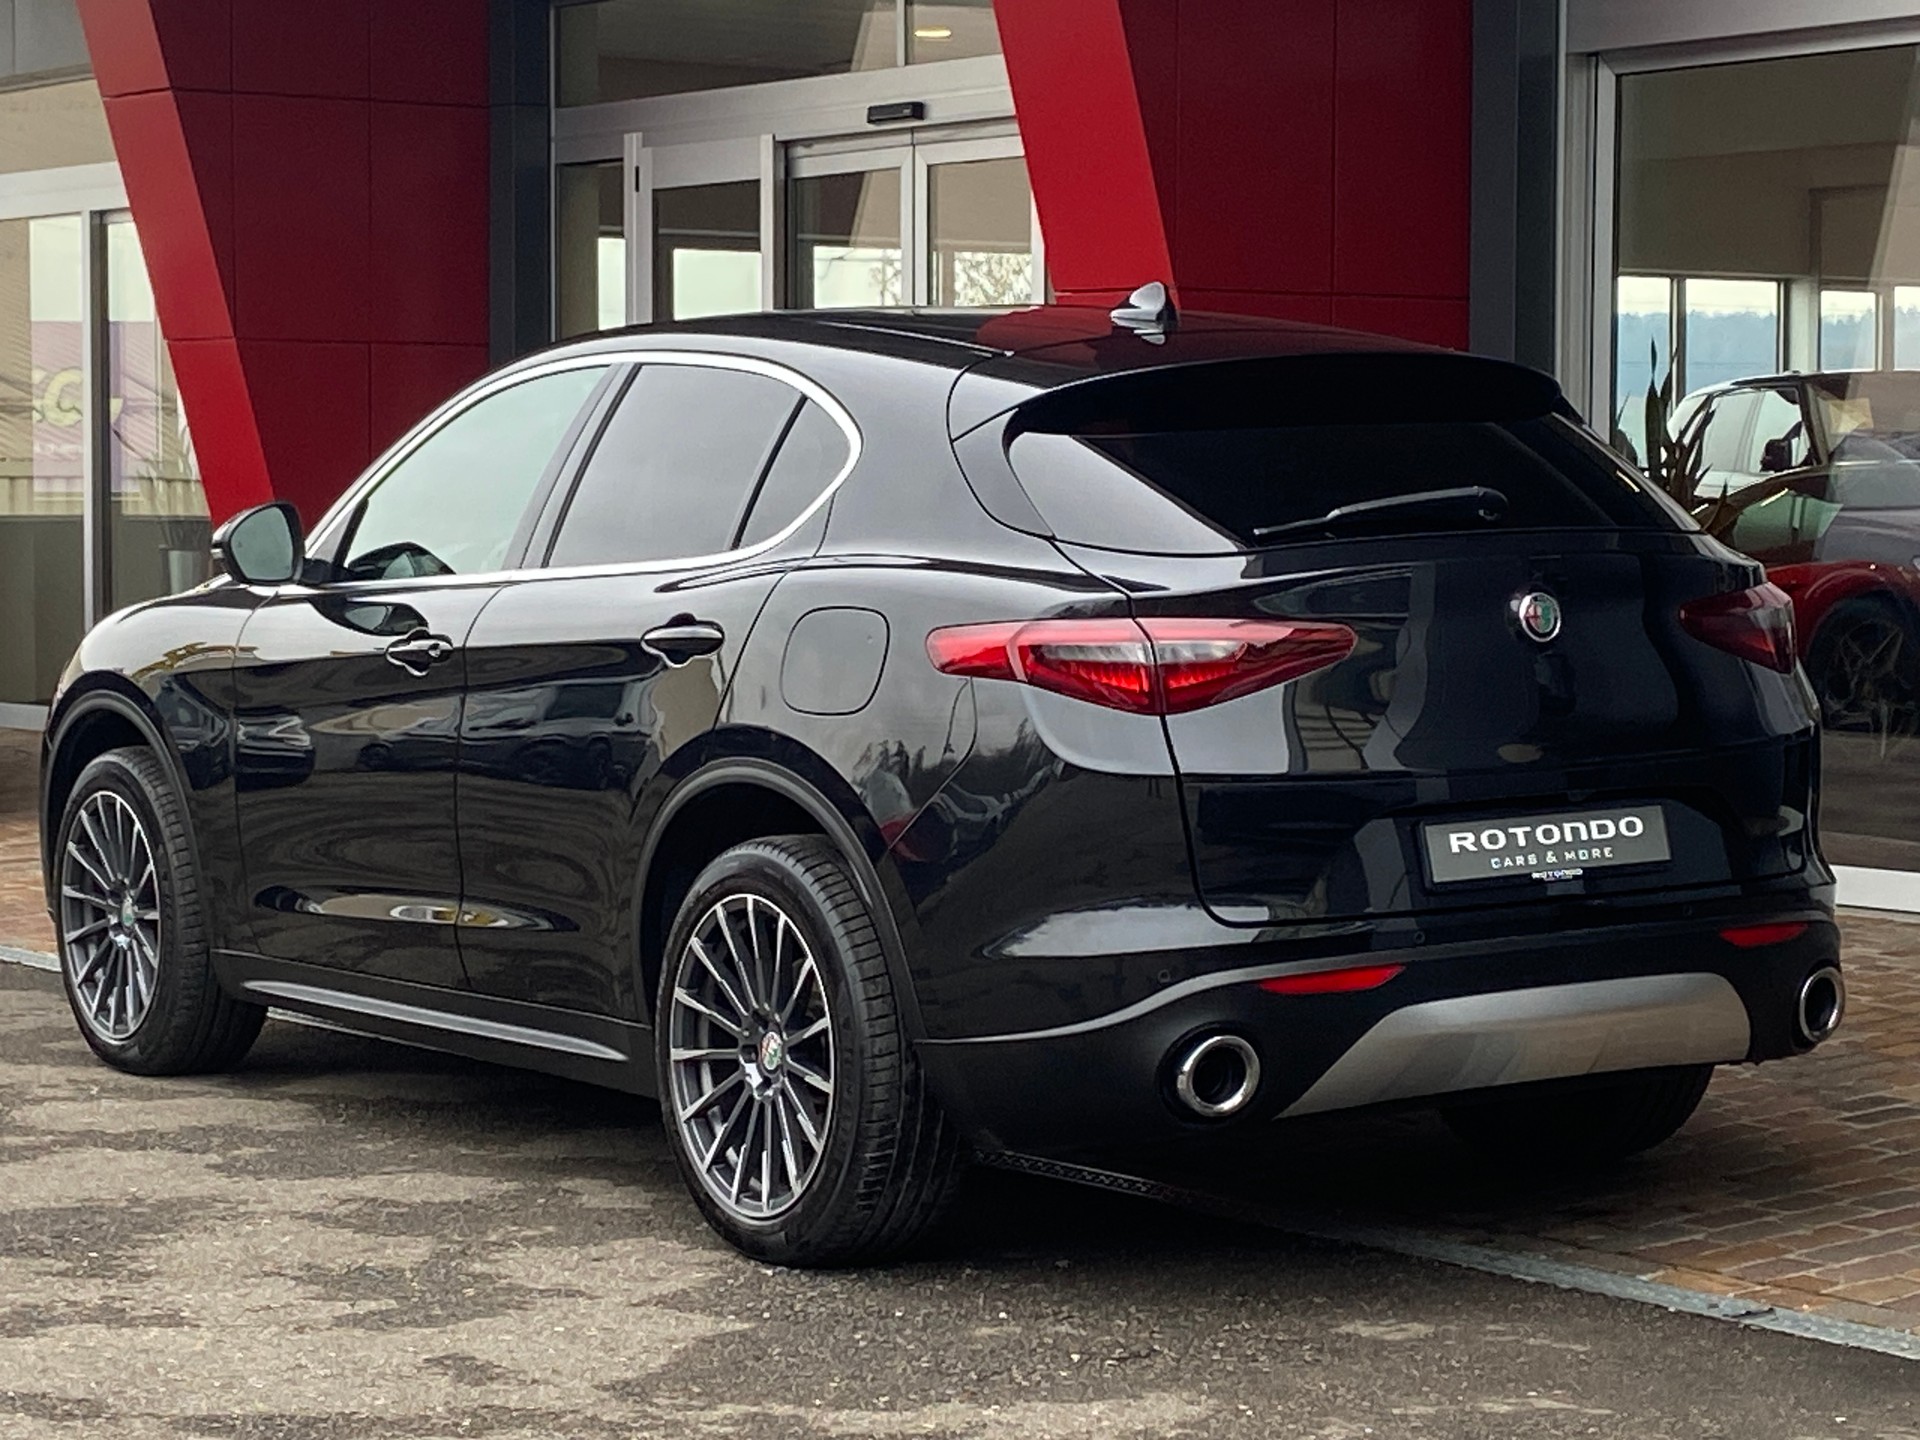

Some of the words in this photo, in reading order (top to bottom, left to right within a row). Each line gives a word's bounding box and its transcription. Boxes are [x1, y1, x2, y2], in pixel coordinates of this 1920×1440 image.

[1449, 815, 1645, 853] ROTONDO
[1490, 853, 1538, 869] CARS
[1545, 850, 1558, 864] &
[1564, 846, 1614, 861] MORE
